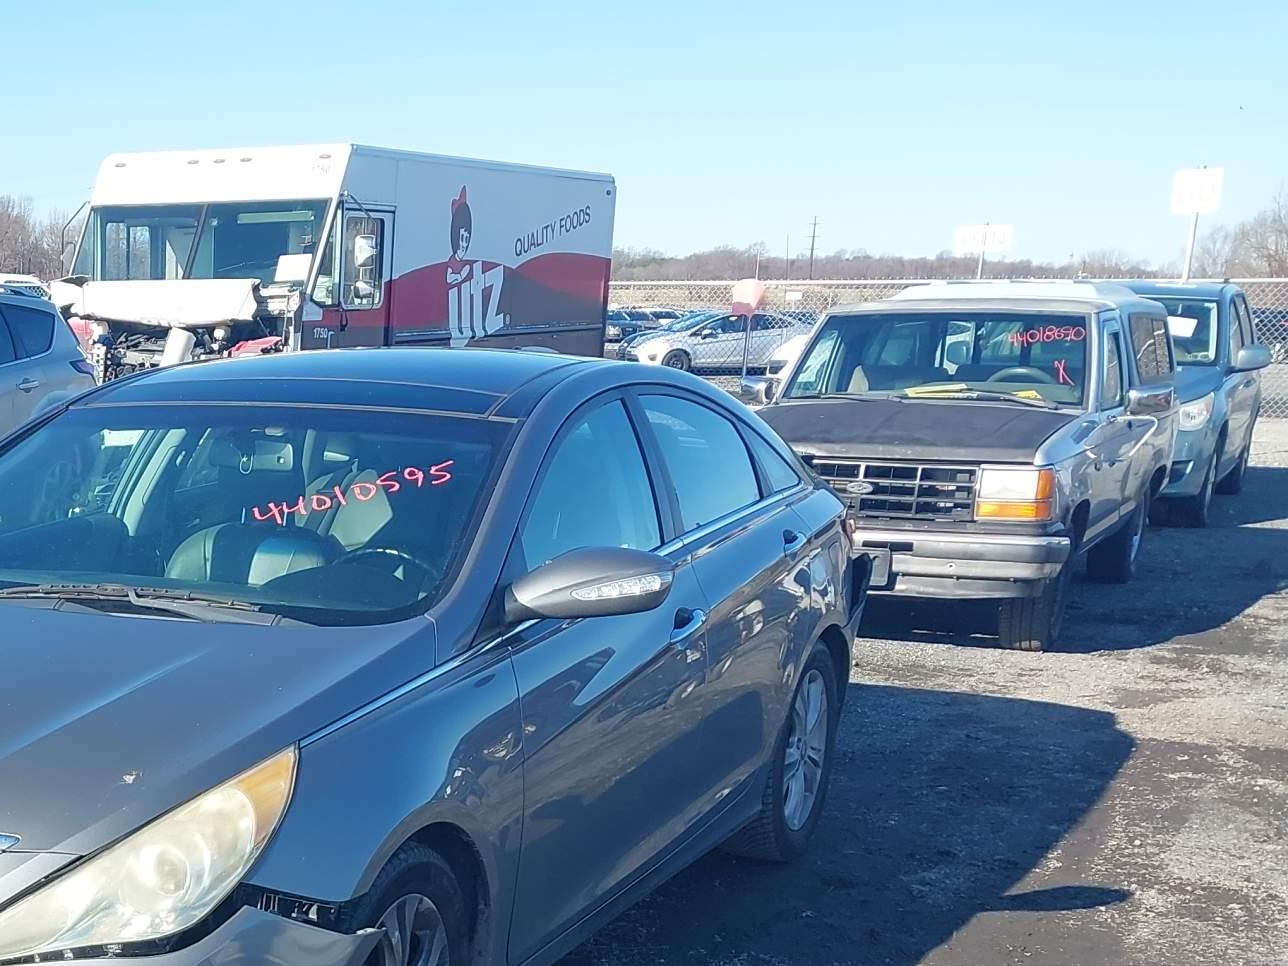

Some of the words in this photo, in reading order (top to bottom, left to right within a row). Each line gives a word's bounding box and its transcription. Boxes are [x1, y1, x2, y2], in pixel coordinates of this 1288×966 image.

[514, 221, 557, 257] QUALITY
[559, 205, 591, 236] FOODS
[313, 327, 328, 339] 1750
[252, 460, 454, 524] 44010595
